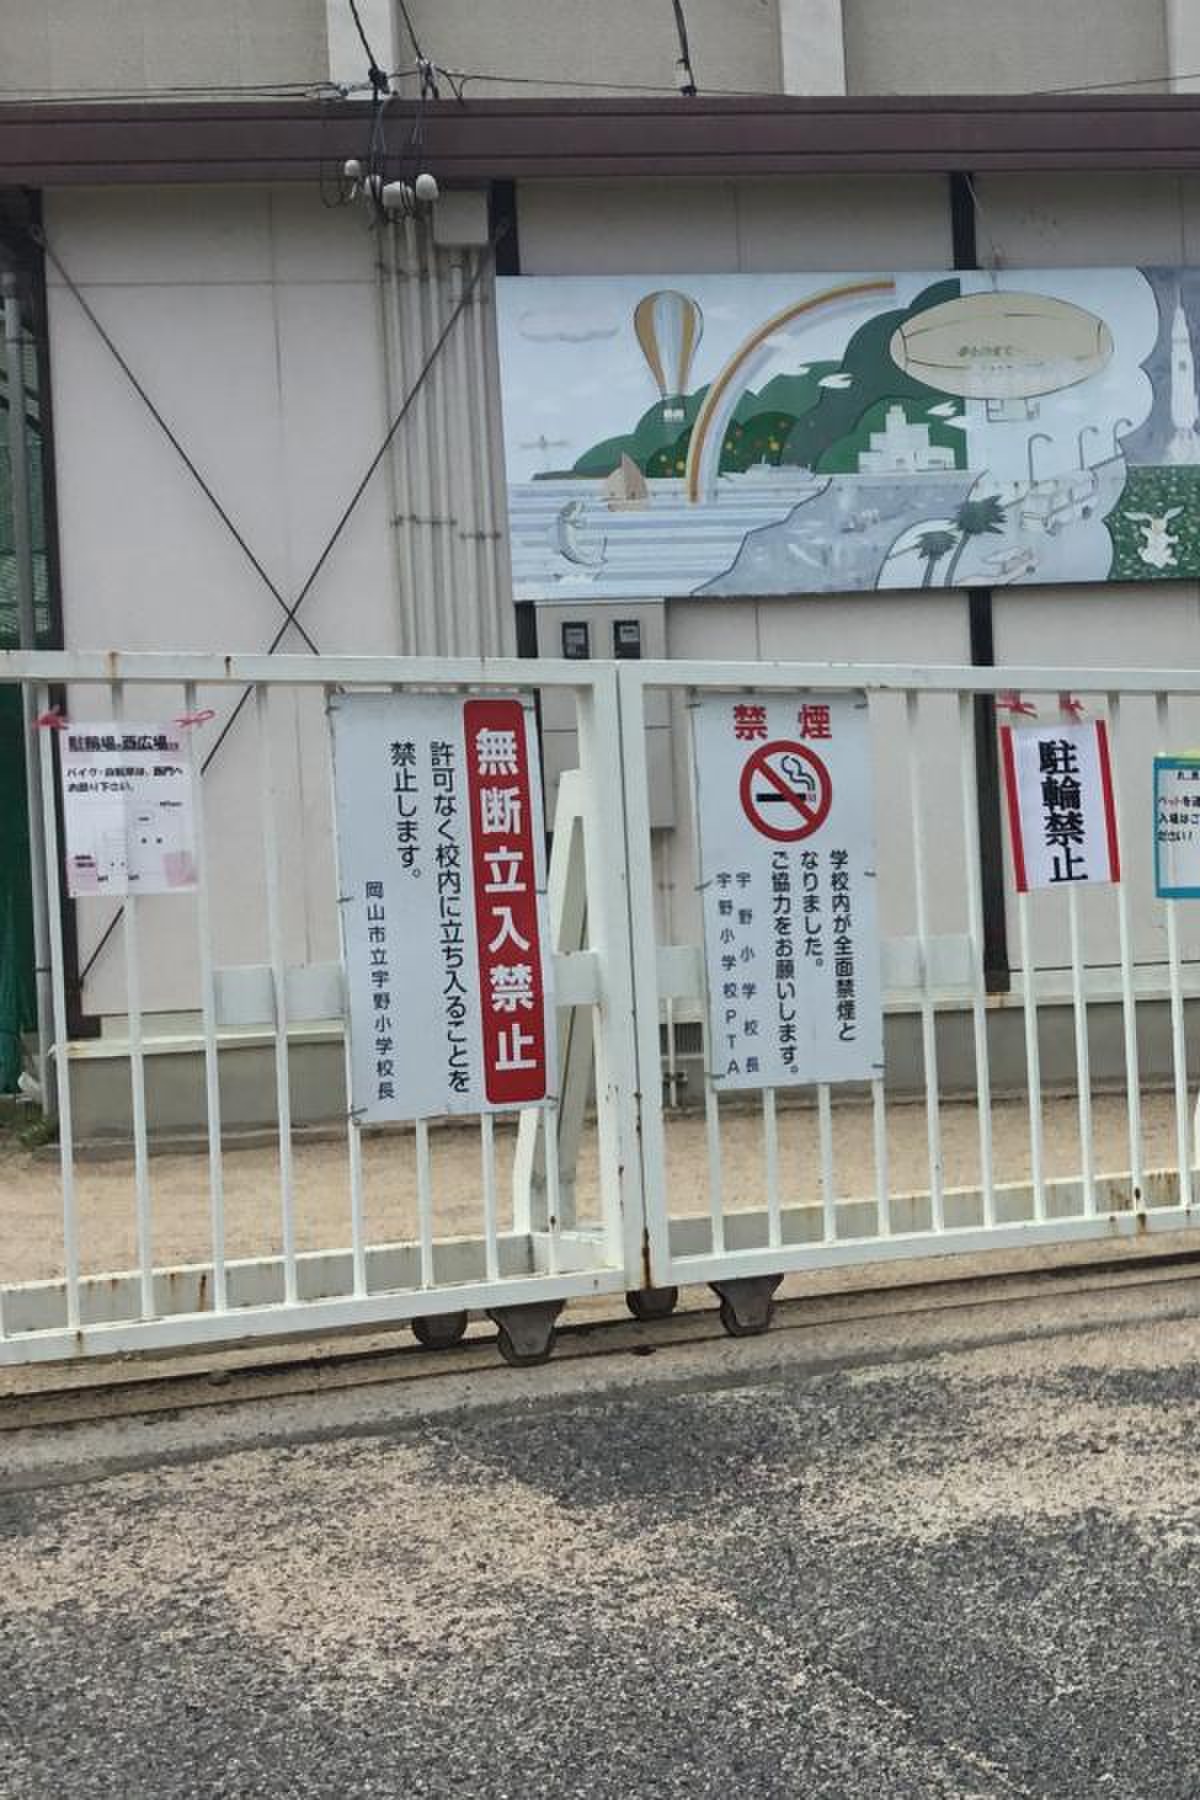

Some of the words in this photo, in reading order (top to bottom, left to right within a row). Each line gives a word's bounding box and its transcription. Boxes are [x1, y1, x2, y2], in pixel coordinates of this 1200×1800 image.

[390, 741, 422, 879] 禁止します。
[733, 703, 833, 742] 禁煙
[1038, 738, 1089, 884] 駐輪禁止
[366, 880, 396, 1100] 岡山市立宇野小学校長
[430, 740, 471, 1093] 許可なく校内に立ち入ることを
[475, 727, 538, 1073] 無断立入禁止
[716, 872, 741, 1076] 宇野小学校PTA
[735, 872, 760, 1074] 宇野小学校長
[771, 850, 798, 1075] ご協力をお願いします。
[800, 850, 824, 968] なりました。
[829, 850, 857, 1044] 学校内が全面禁煙と
